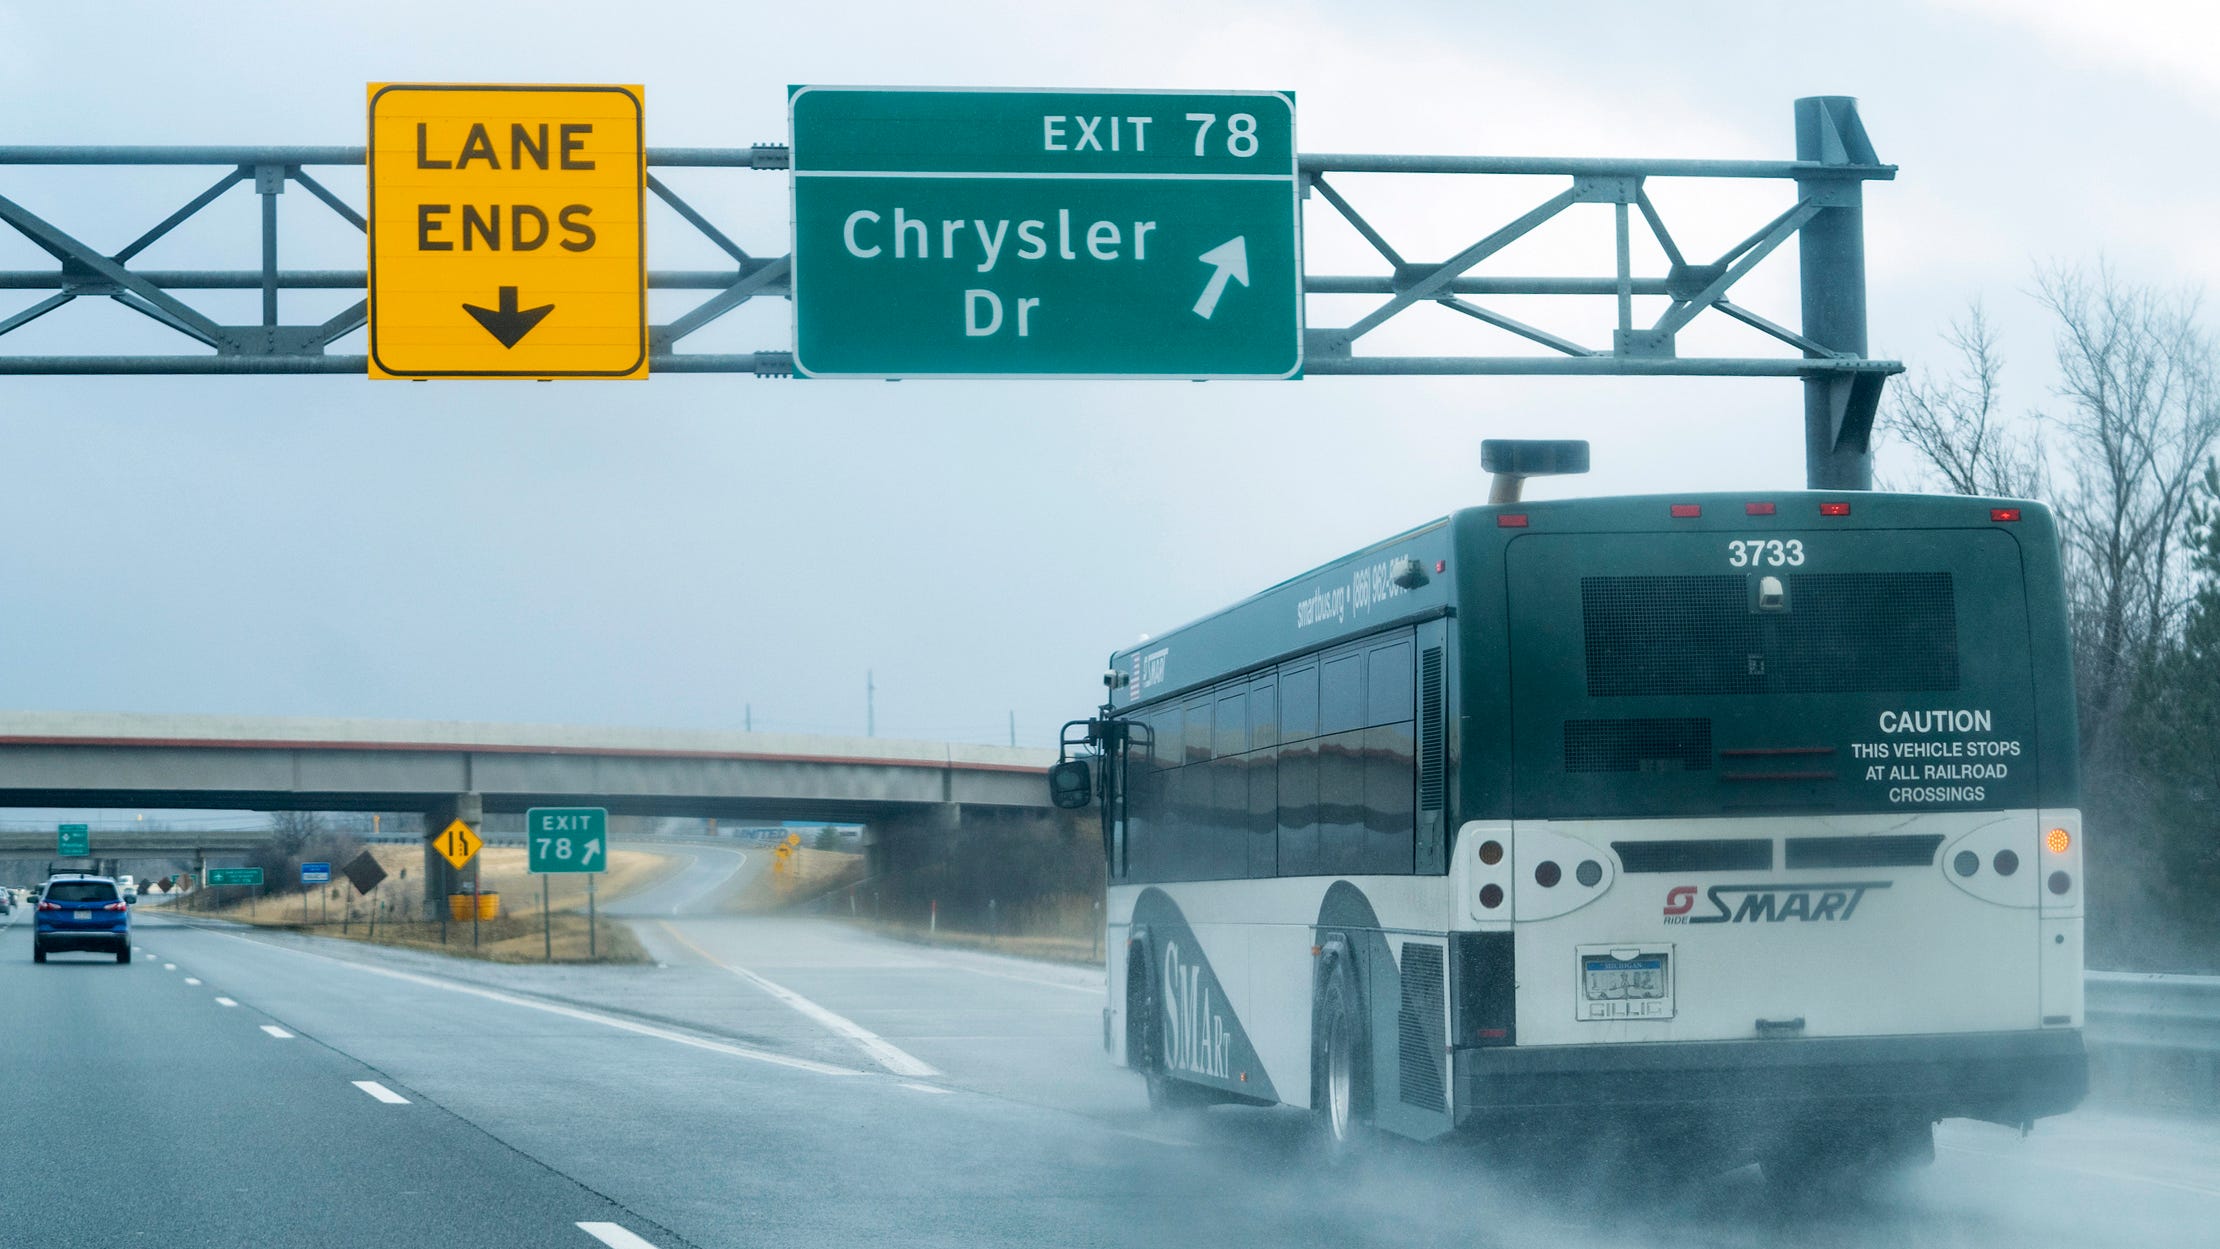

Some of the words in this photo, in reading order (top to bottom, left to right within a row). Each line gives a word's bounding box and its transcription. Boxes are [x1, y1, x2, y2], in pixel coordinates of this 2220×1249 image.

[417, 122, 596, 171] LANE
[1042, 115, 1153, 152] EXIT
[1185, 112, 1260, 158] 78
[418, 204, 597, 252] ENDS
[842, 207, 1157, 273] Chrysler
[964, 288, 1040, 337] Dr
[1728, 538, 1805, 568] 3733
[1297, 585, 1345, 629] smartbus.org
[1879, 709, 1992, 733] CAUTION
[1851, 743, 1889, 758] THIS
[1893, 742, 1963, 758] VEHICLE
[1967, 741, 2021, 757] STOPS
[1865, 766, 1885, 780] AT
[1889, 765, 1920, 780] ALL
[1924, 764, 2008, 779] RAILROAD
[1889, 786, 1985, 803] CROSSINGS
[542, 815, 591, 831] EXIT
[536, 837, 573, 860] 78
[1663, 915, 1689, 925] RIDE
[1689, 880, 1893, 924] SMART
[1164, 940, 1230, 1078] SMART
